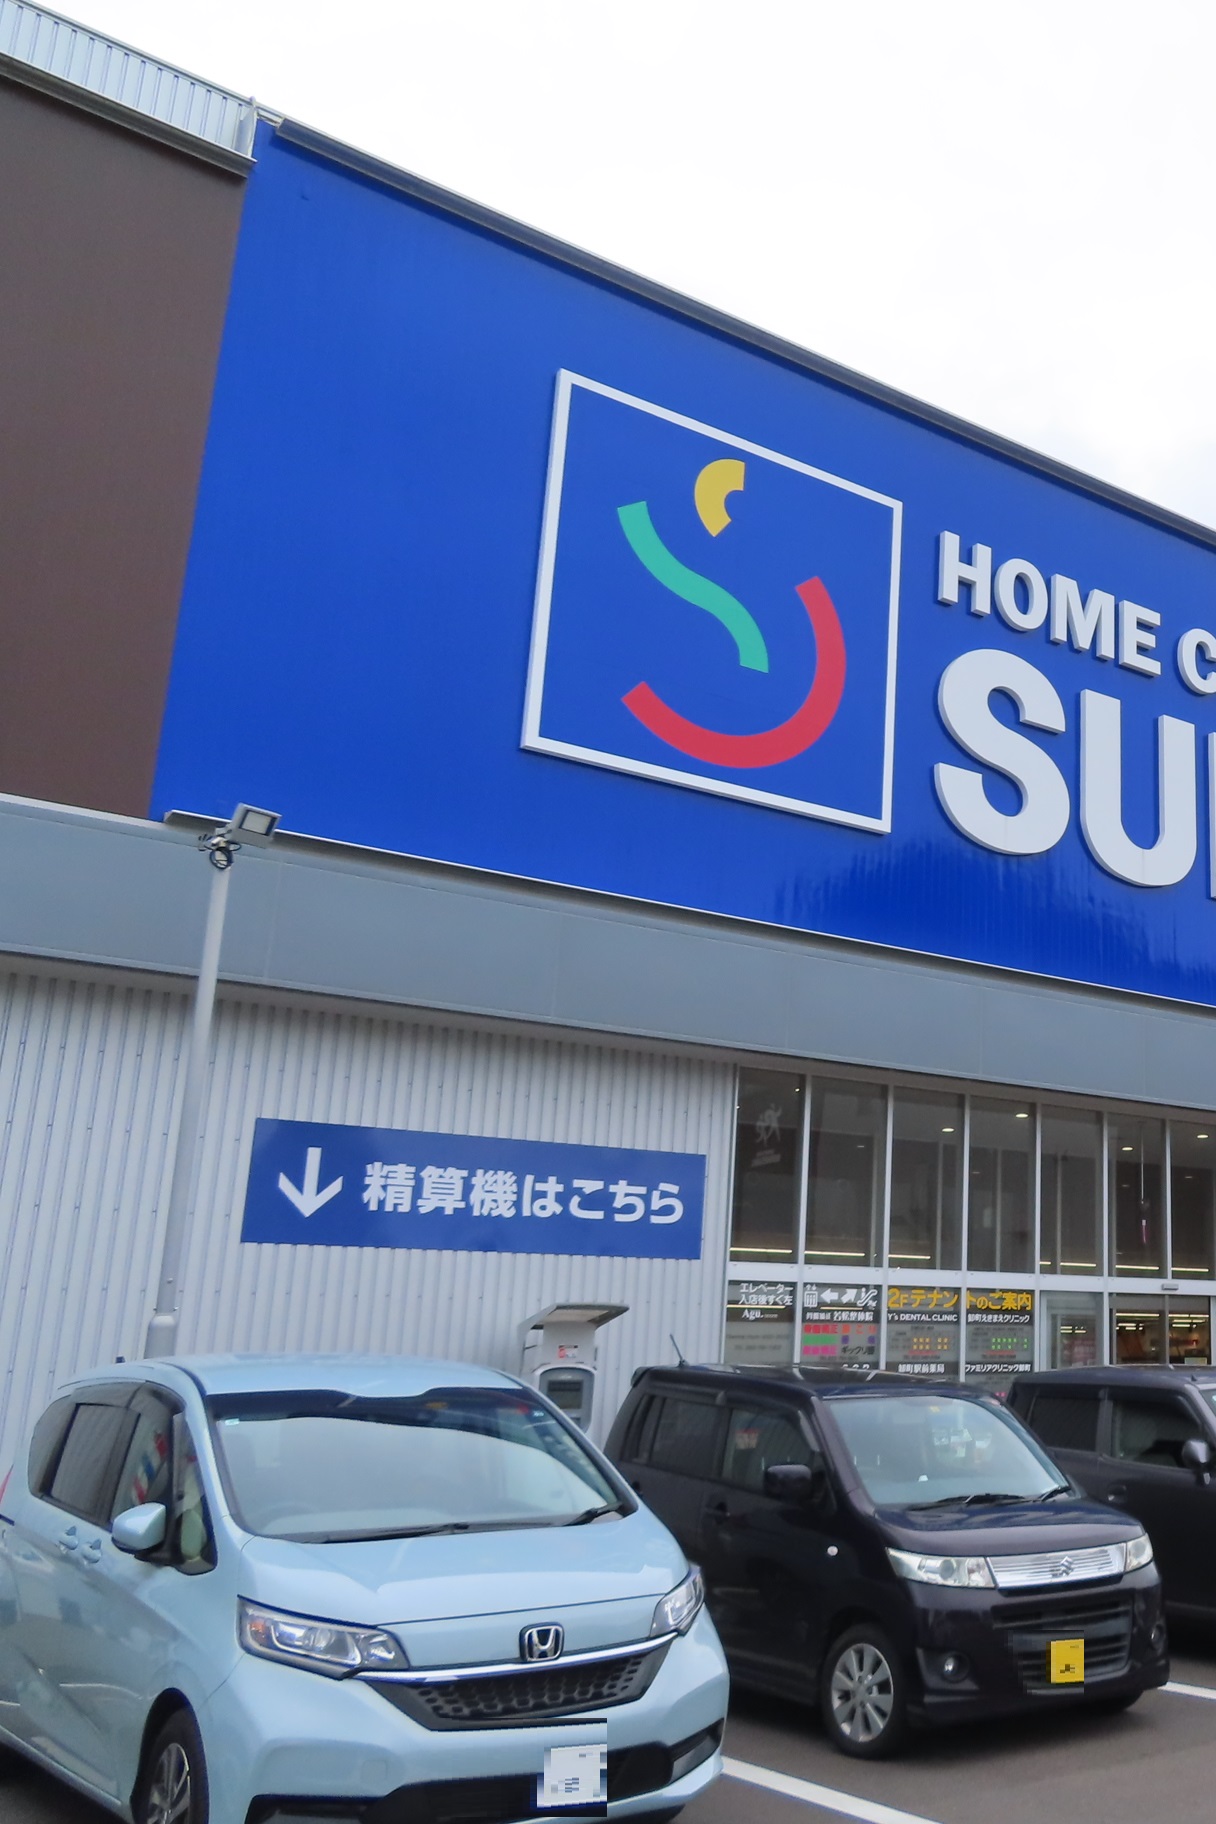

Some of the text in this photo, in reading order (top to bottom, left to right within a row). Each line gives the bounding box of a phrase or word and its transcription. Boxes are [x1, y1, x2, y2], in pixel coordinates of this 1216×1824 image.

[938, 530, 1161, 677] HOME
[362, 1160, 685, 1226] 精算機はこちら
[739, 1282, 794, 1294] エレベーター
[900, 1314, 931, 1322] DENTAL
[932, 1314, 958, 1322] CLINIC
